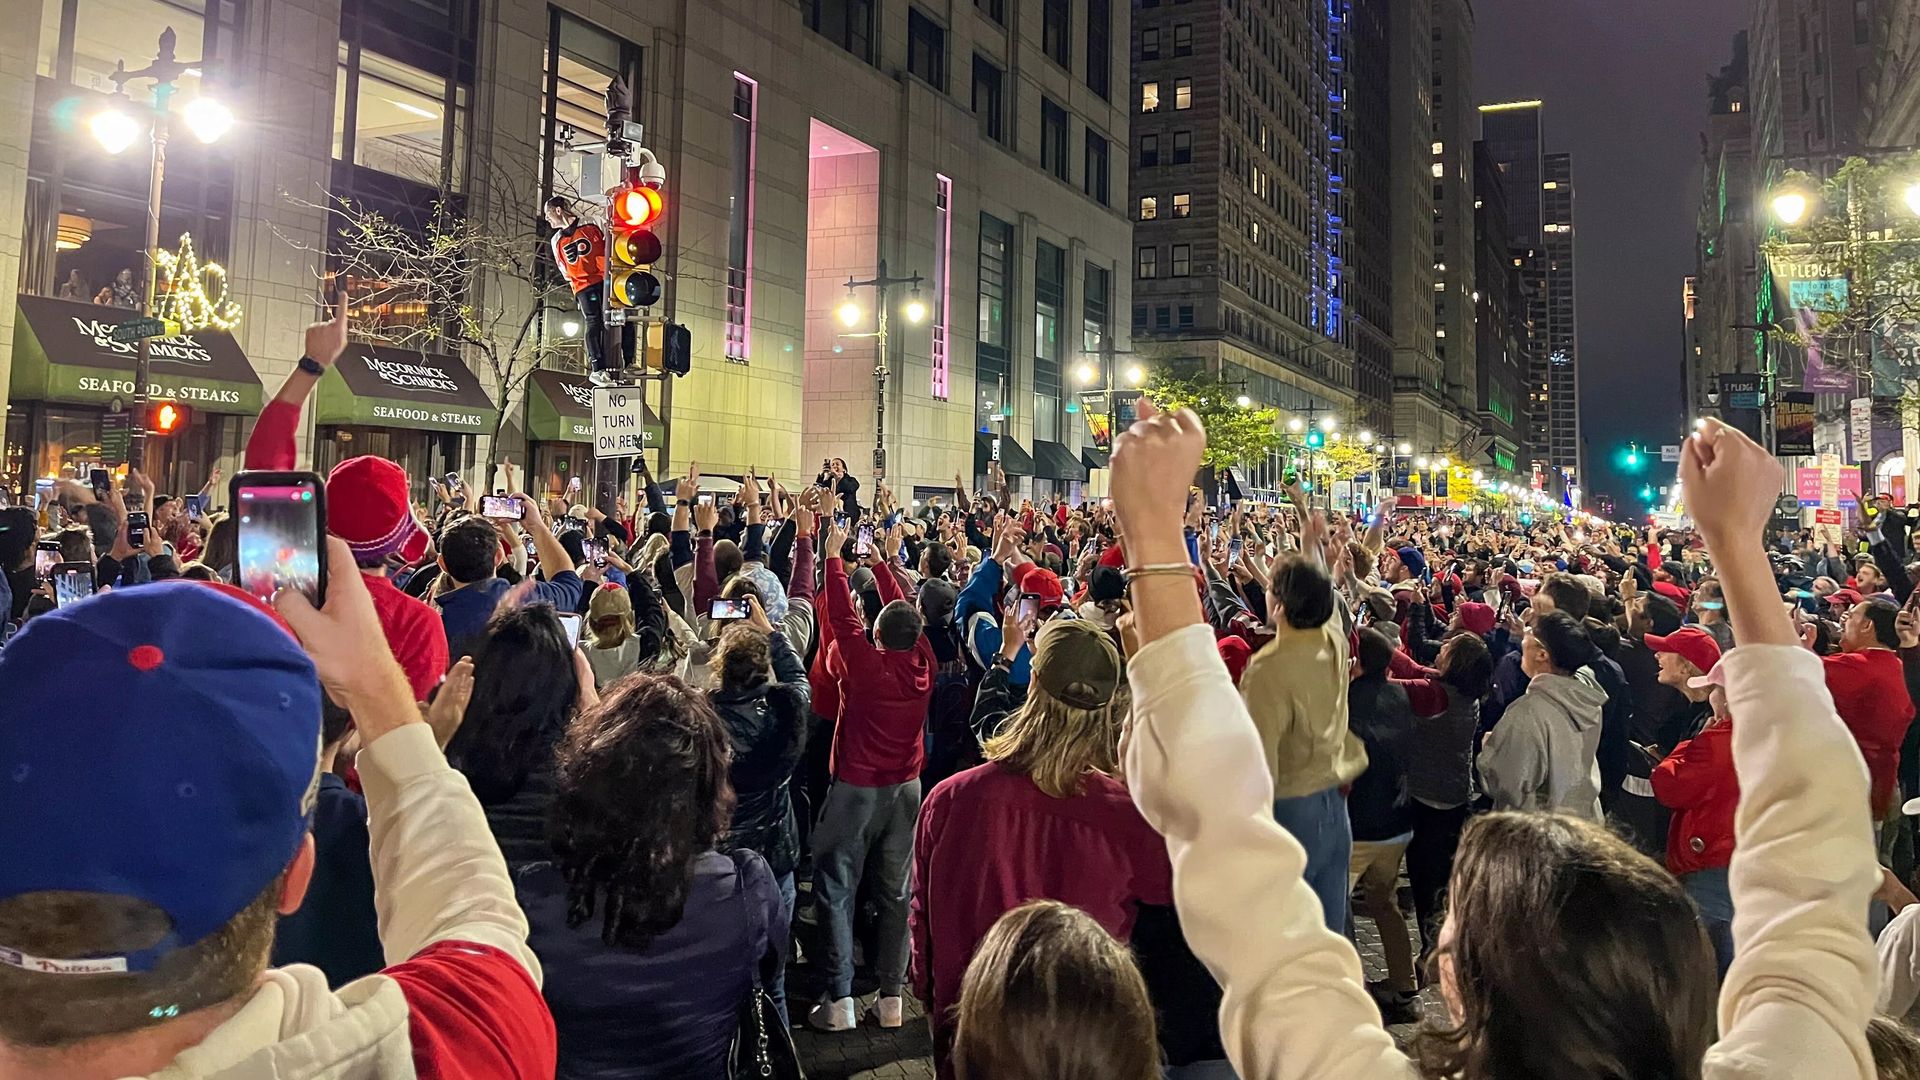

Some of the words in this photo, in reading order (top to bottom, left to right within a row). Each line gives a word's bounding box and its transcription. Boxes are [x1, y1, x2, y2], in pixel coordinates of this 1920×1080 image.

[113, 326, 136, 341] SOUTH
[137, 323, 156, 337] PENN
[79, 377, 162, 396] SEAFOD
[166, 388, 176, 398] &
[179, 386, 240, 404] STEAKS
[609, 394, 627, 408] NO
[373, 406, 429, 421] SEAFOOD
[431, 413, 439, 422] &
[440, 412, 482, 426] STEAKS
[602, 415, 634, 428] TURN
[599, 436, 616, 449] ON
